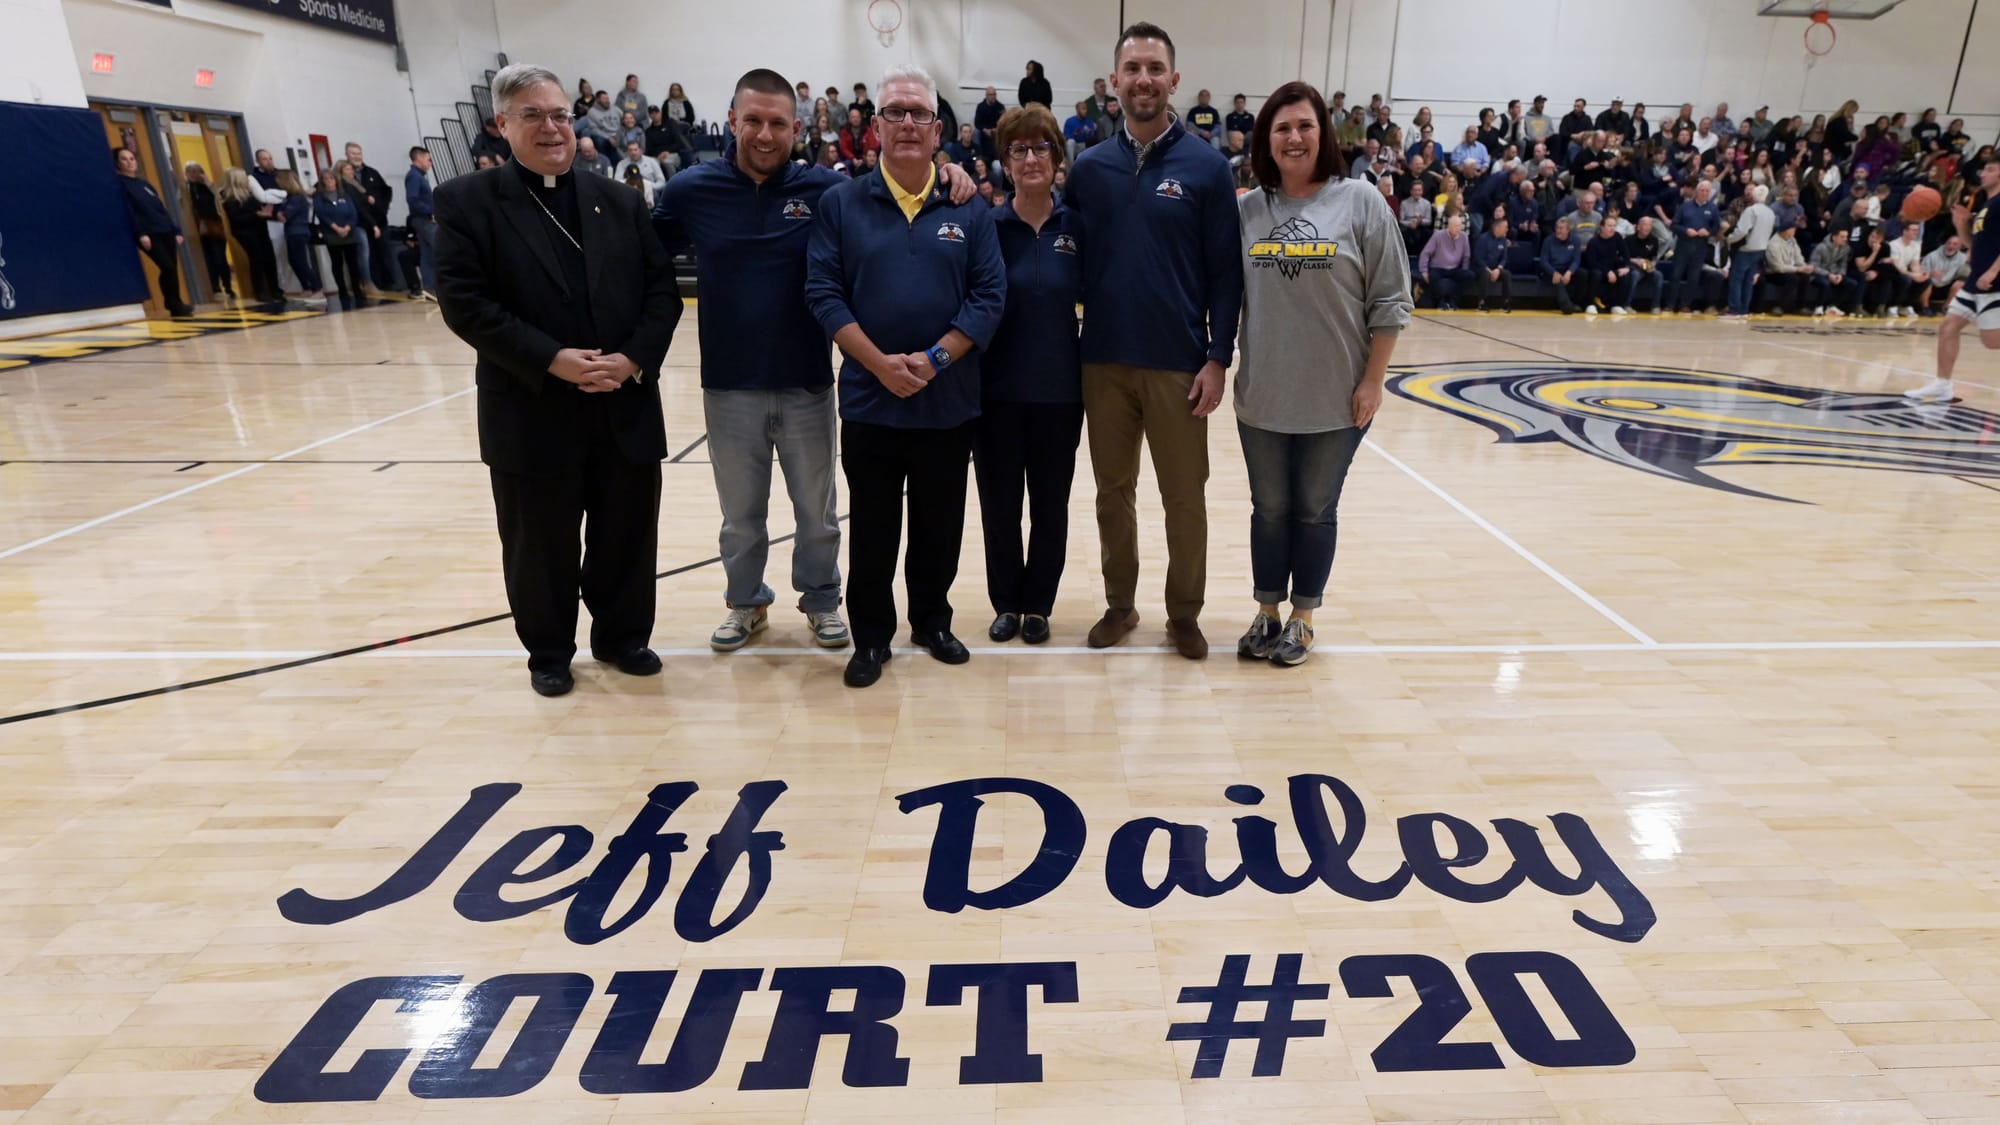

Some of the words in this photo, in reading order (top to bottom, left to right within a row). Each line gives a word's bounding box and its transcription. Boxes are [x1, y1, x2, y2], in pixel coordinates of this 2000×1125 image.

[299, 0, 337, 19] Sports
[339, 4, 386, 32] Medicine
[1248, 242, 1283, 256] JEFF
[1283, 242, 1338, 257] DAILEY
[1262, 261, 1275, 269] OFF
[1303, 262, 1333, 270] CLASSIC
[277, 779, 788, 945] Jeff
[895, 773, 1657, 943] Dailey
[254, 961, 1079, 1103] COURT
[1166, 951, 1636, 1079] #20
